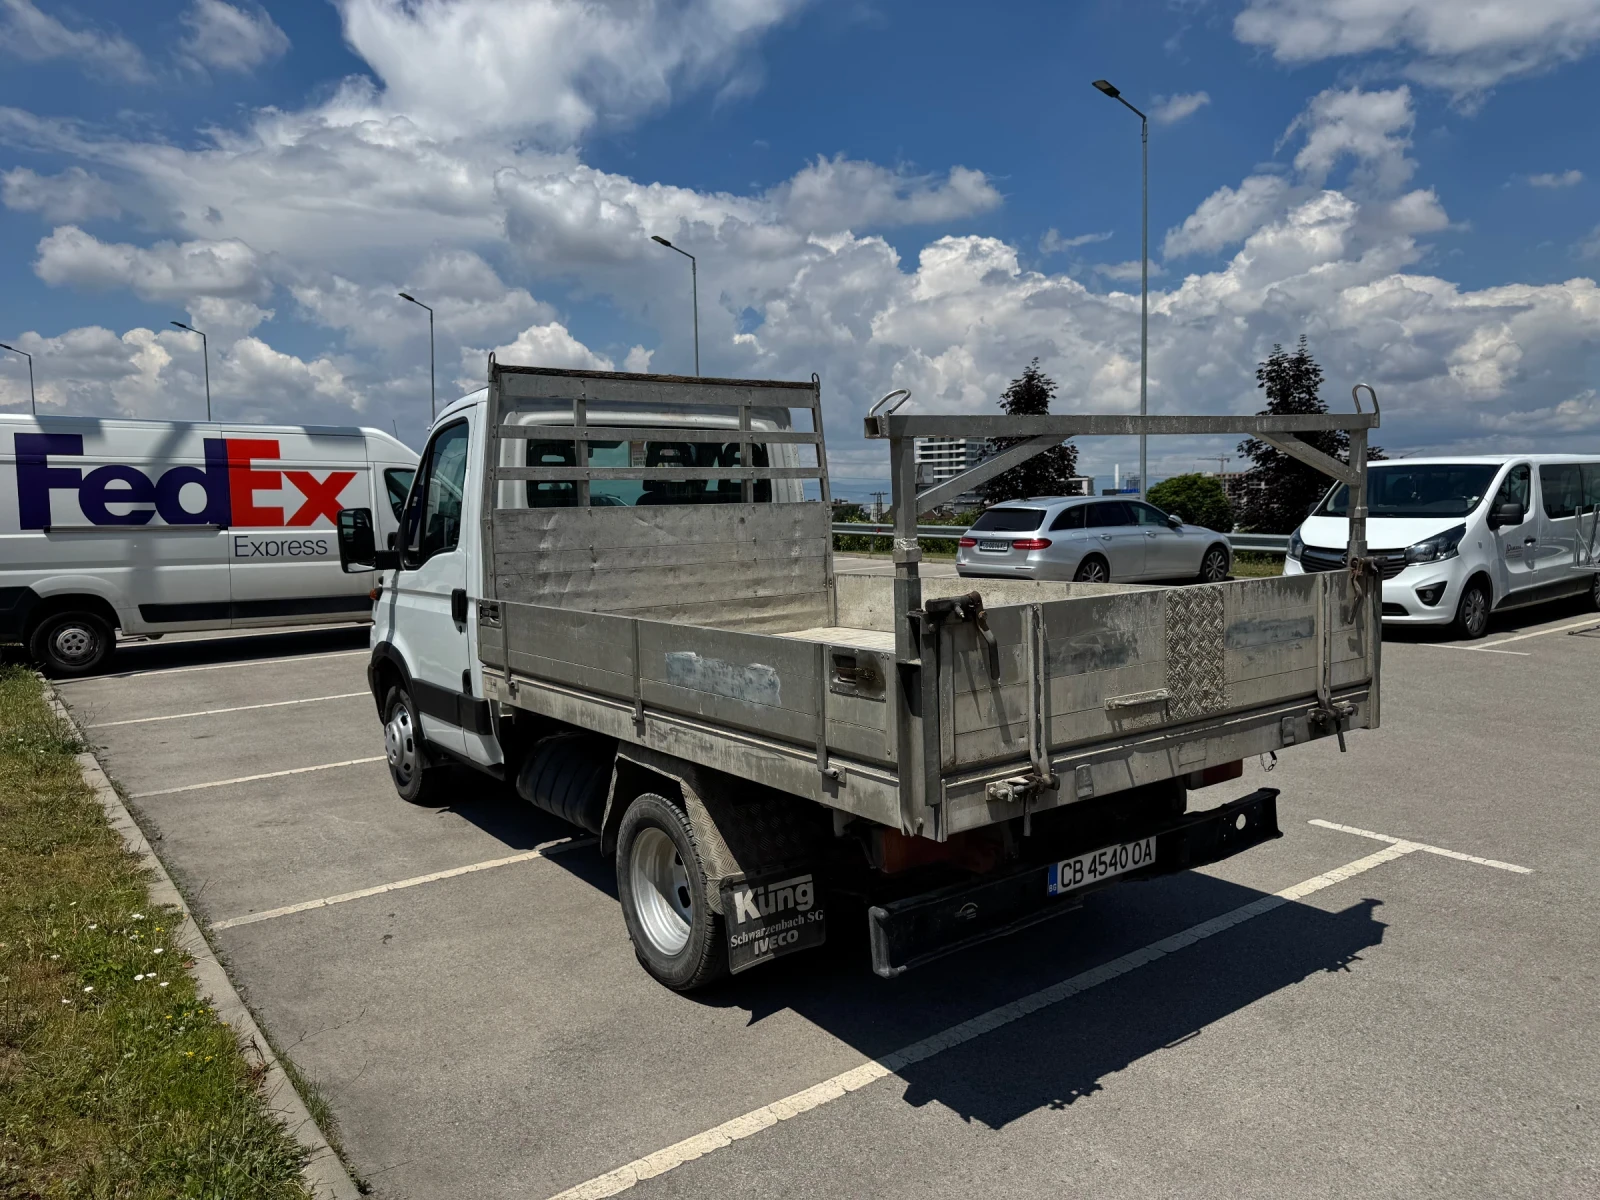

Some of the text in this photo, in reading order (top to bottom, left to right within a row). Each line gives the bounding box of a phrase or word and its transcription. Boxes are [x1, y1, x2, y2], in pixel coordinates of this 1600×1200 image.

[14, 432, 357, 530] FedEx
[233, 535, 328, 558] Express
[1060, 838, 1152, 888] CB 4540 OA
[734, 874, 814, 924] Küng
[1048, 883, 1057, 892] BG
[730, 909, 824, 947] Schwarzenbach SG
[754, 929, 799, 955] IVECO
